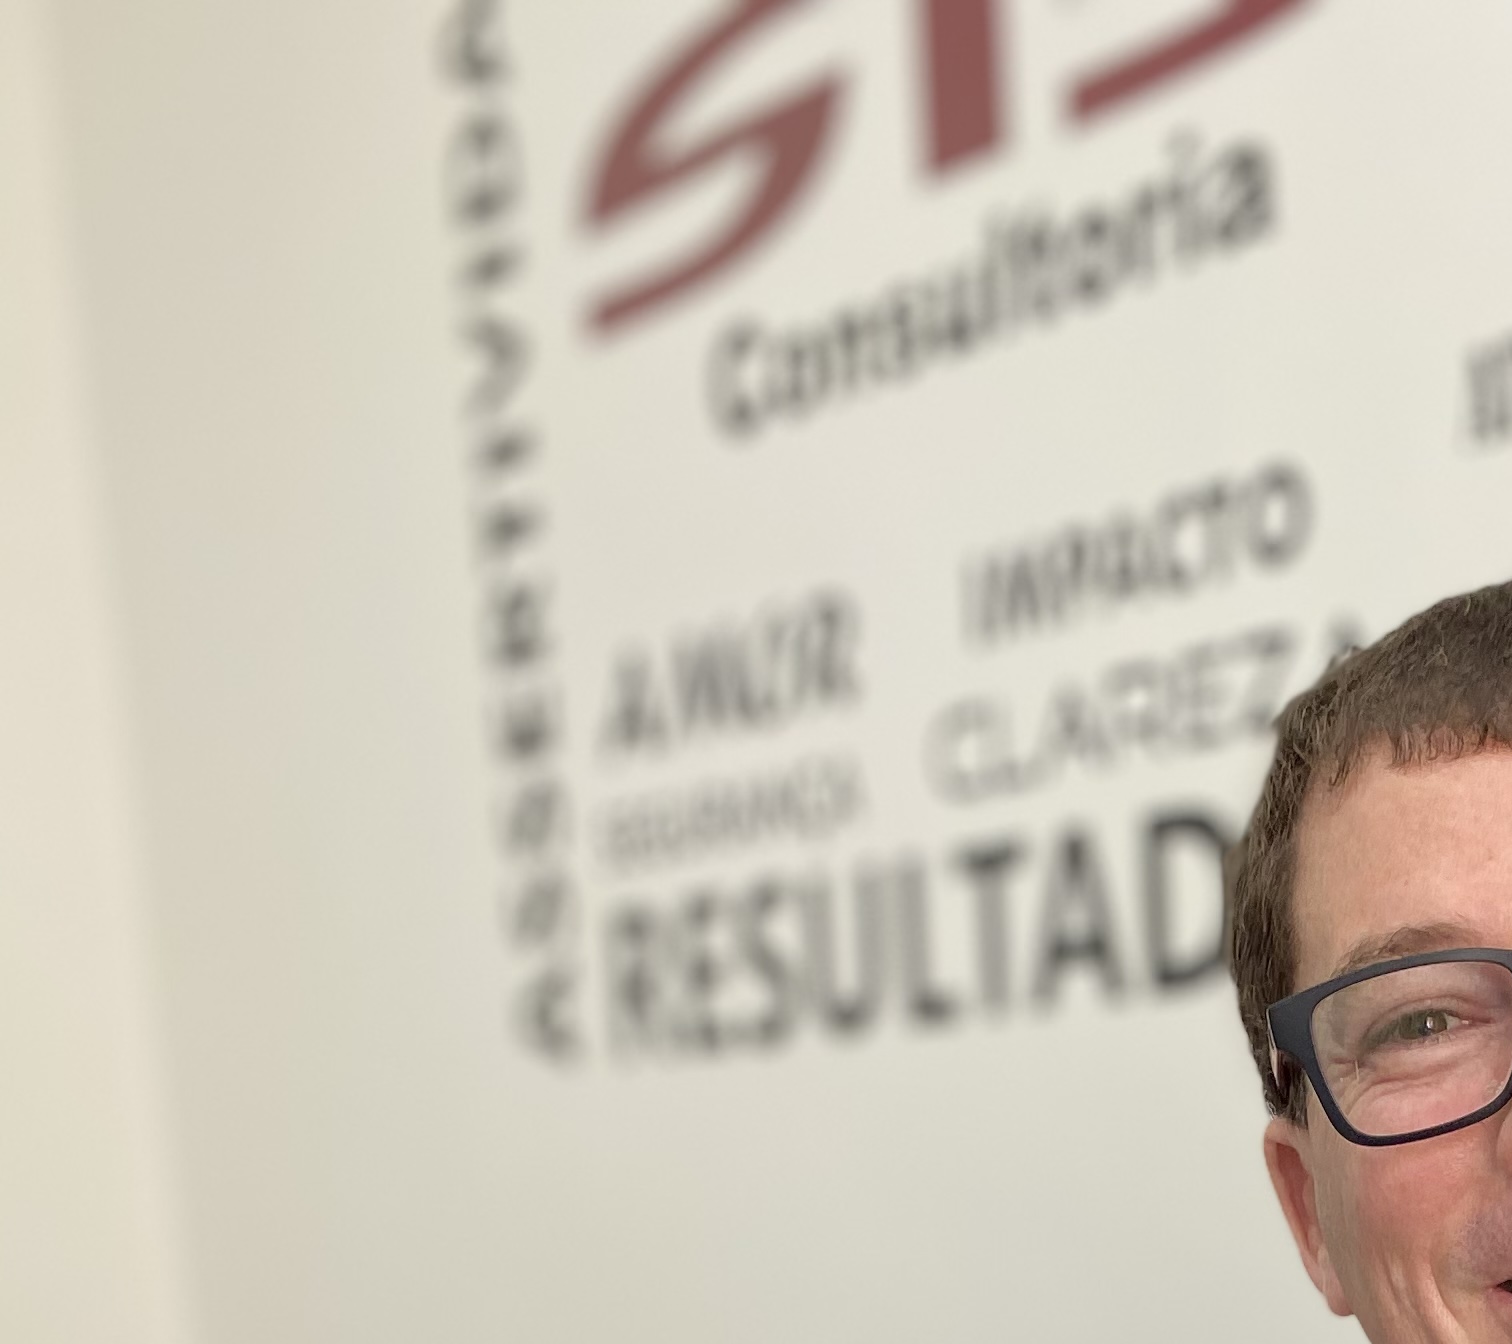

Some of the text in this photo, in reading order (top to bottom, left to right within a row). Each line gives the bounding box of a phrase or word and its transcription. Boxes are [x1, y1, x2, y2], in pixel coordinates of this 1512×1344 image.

[578, 0, 1322, 340] SI
[704, 130, 1276, 440] Consultoria
[961, 460, 1314, 650] IMPACTO
